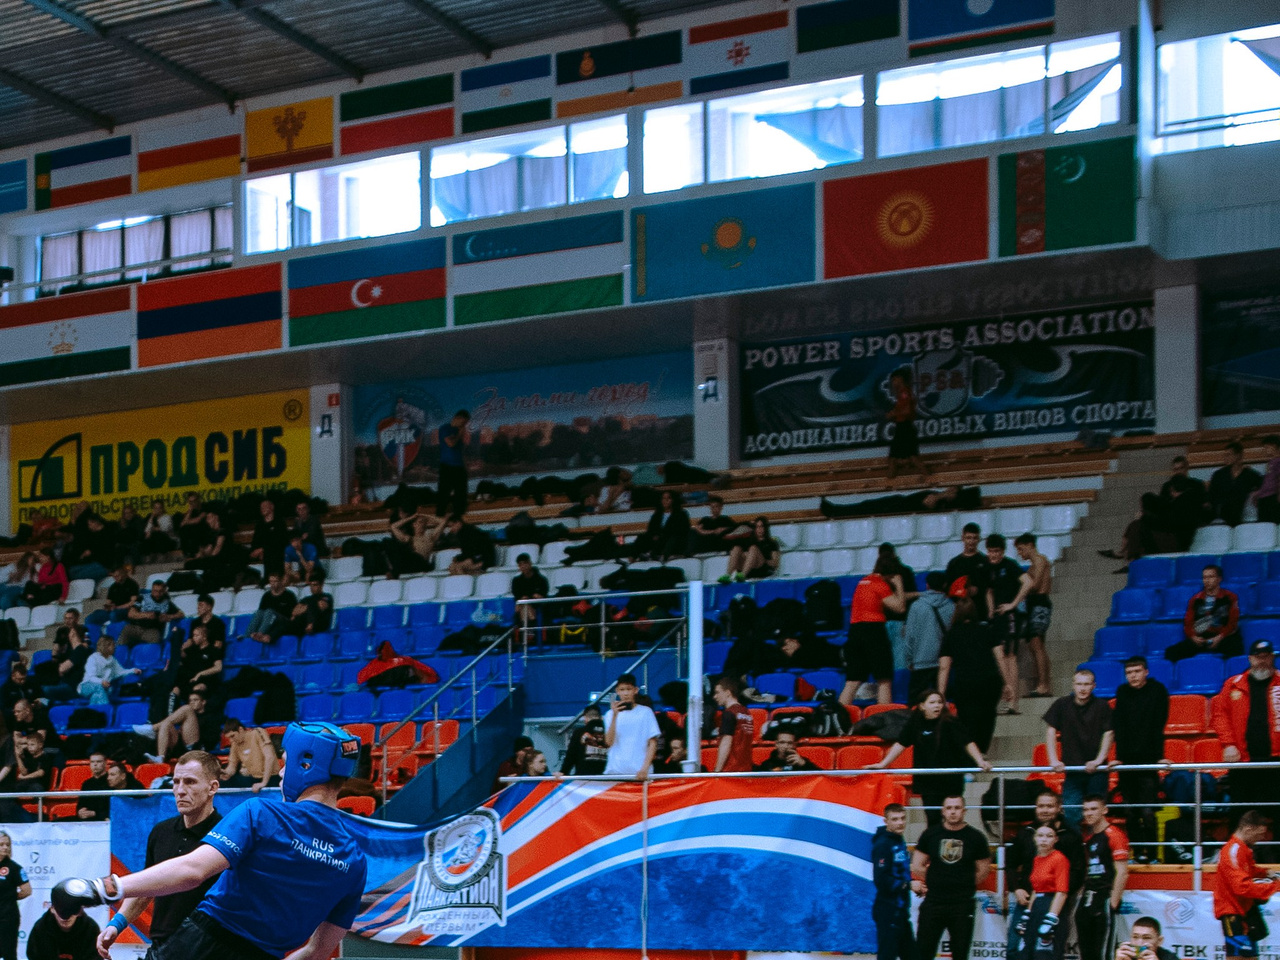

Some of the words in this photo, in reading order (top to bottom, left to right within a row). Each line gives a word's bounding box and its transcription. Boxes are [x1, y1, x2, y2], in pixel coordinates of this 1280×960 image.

[744, 341, 841, 370] POWER
[849, 327, 956, 359] SPORTS
[960, 306, 1156, 348] ASSOCIATION
[744, 423, 877, 454] АССОЦИАЦИЯ
[992, 404, 1066, 431] ВИДОВ
[1070, 399, 1157, 425] СПОРТА
[90, 425, 288, 496] ПРОДСИБ
[290, 838, 350, 873] ПАНКРАТИОН
[312, 837, 335, 853] RUS
[1171, 944, 1208, 958] ТВК
